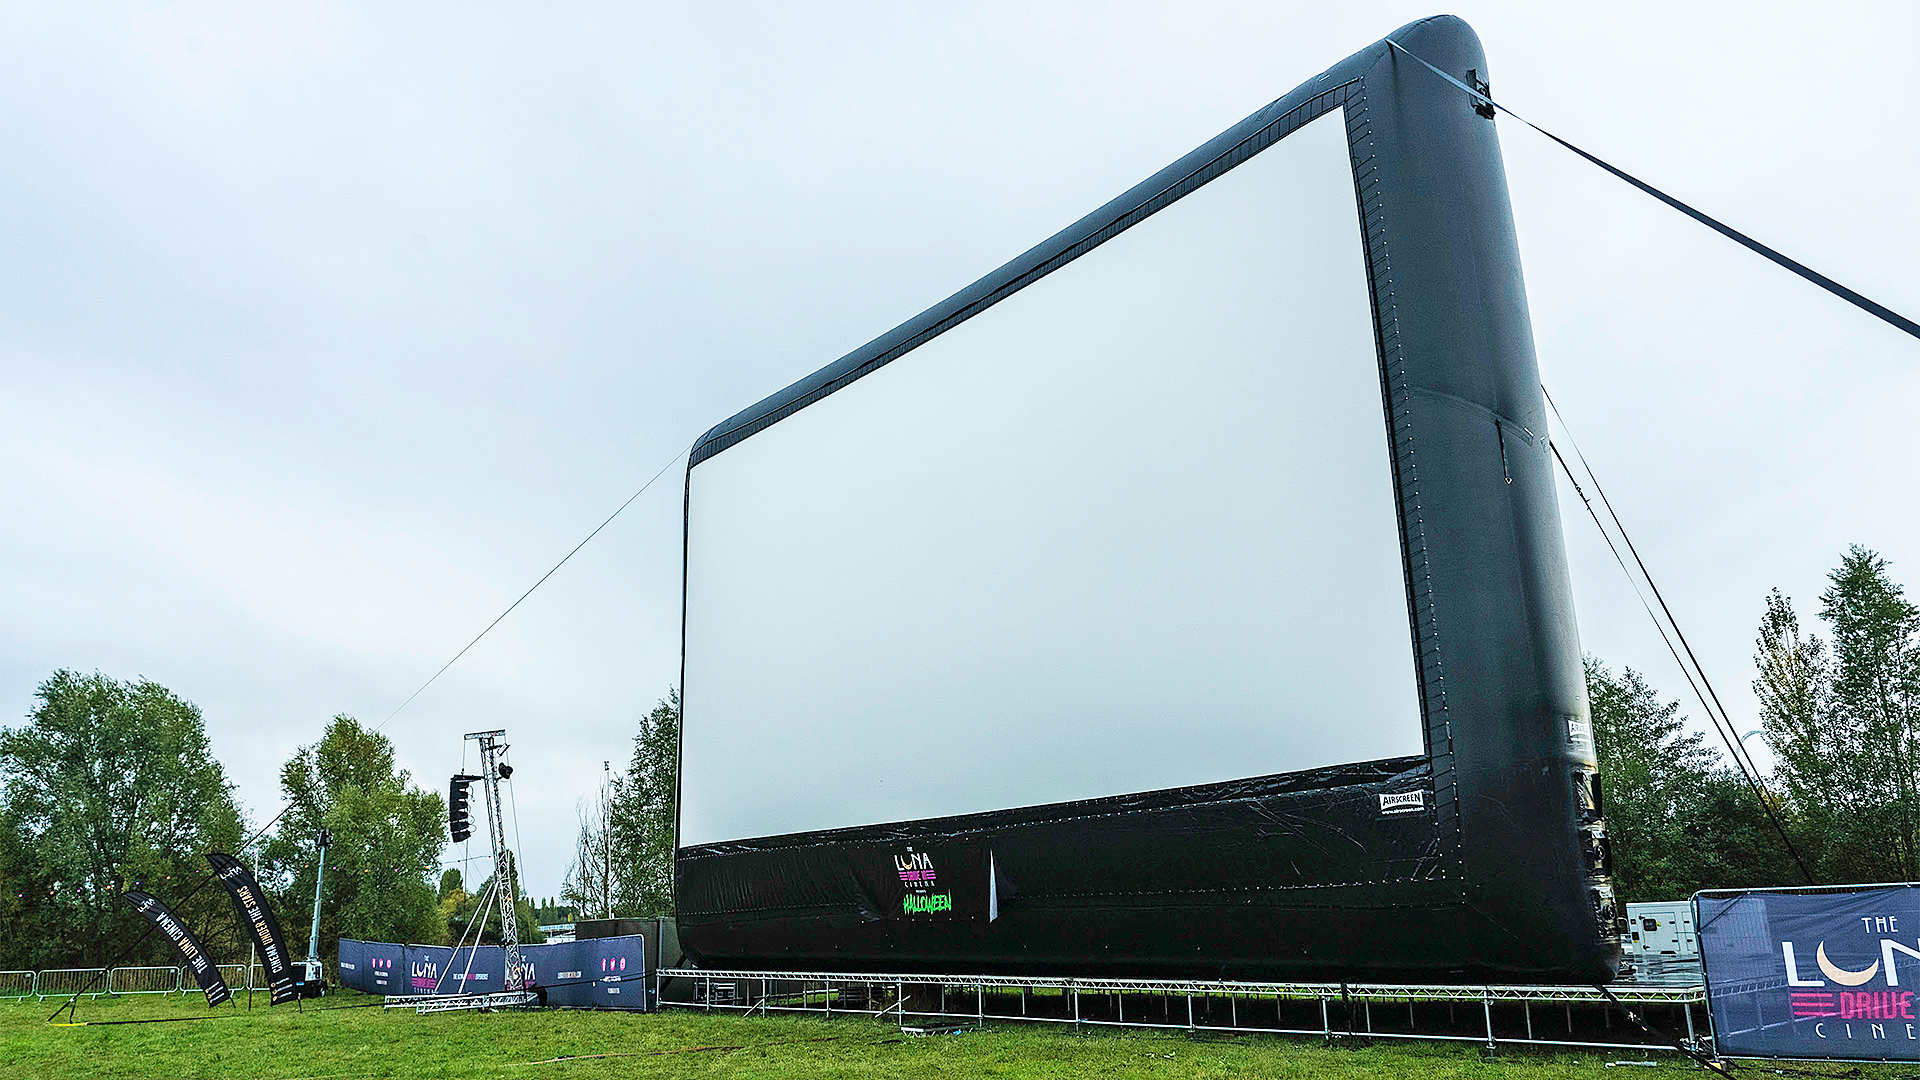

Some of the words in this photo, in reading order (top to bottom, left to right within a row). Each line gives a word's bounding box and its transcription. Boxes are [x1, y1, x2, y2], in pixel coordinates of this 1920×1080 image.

[1383, 792, 1421, 806] AIRSCREEN
[1381, 806, 1425, 815] www.airscreen.com
[894, 853, 934, 871] LUNA
[904, 880, 936, 888] CINEMA
[236, 885, 256, 909] STARS
[902, 889, 952, 915] HALLOWEEN
[247, 906, 263, 923] THE
[1861, 915, 1899, 934] THE
[155, 912, 184, 942] CINEMA
[254, 920, 274, 946] UNDER
[177, 936, 198, 960] LUNA
[191, 954, 208, 975] THE
[265, 943, 283, 974] CINEMA
[411, 961, 438, 979] LUNA
[1840, 991, 1916, 1019] DRIVE
[1815, 1022, 1917, 1040] CINE
